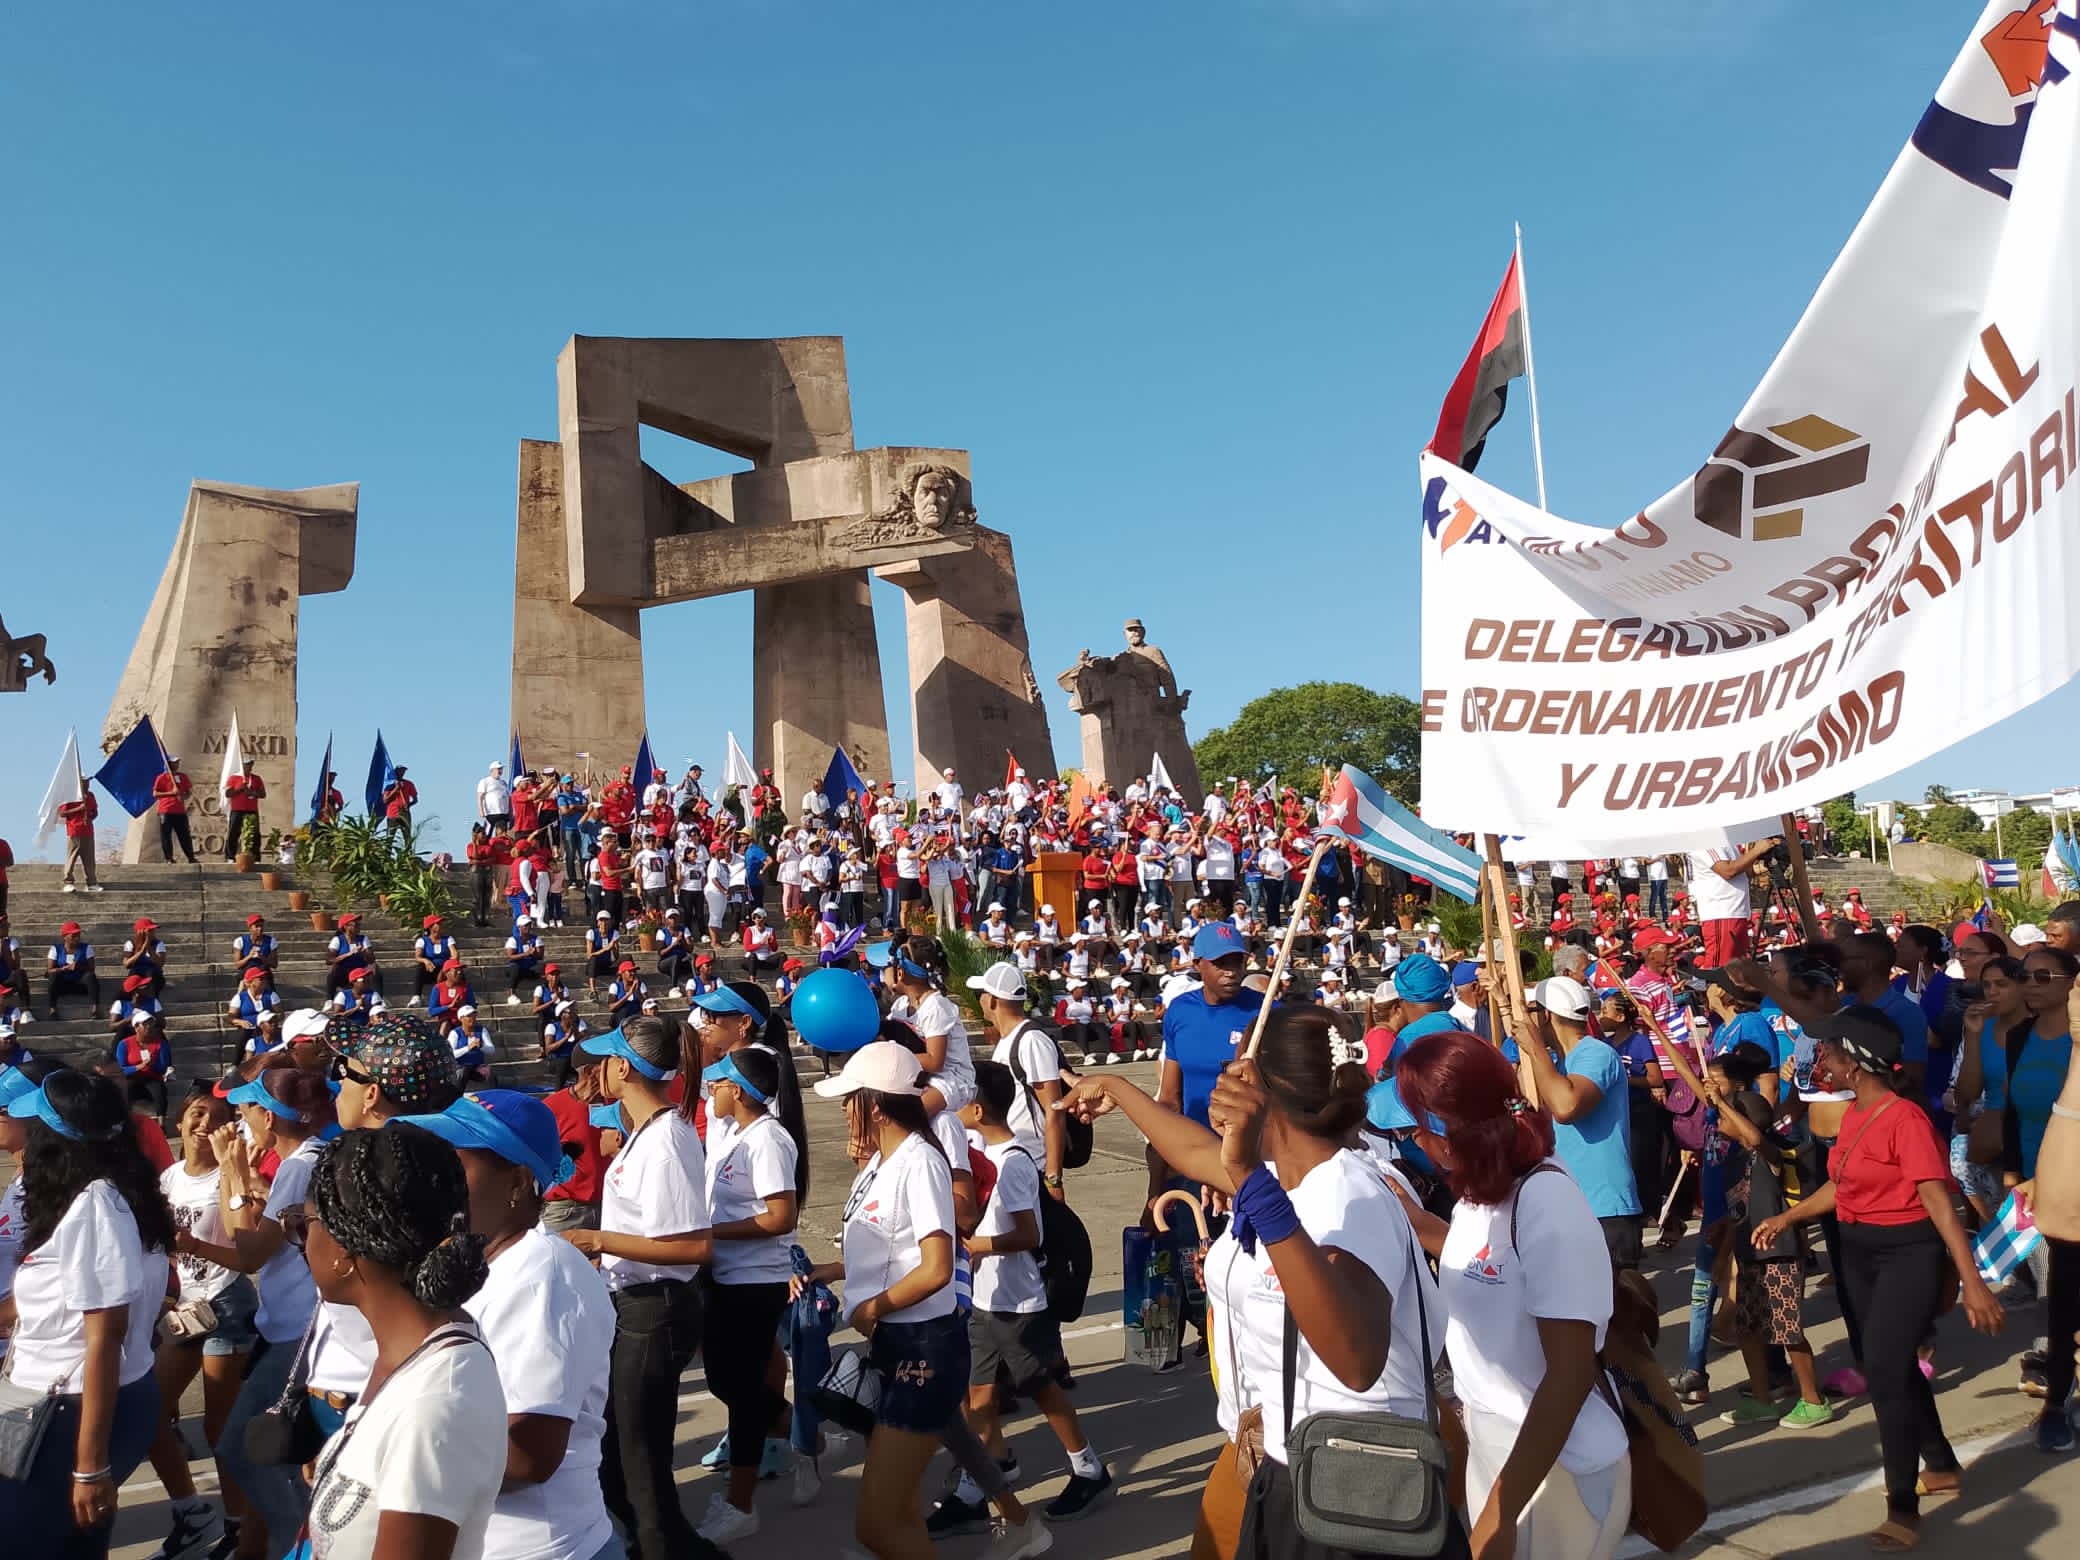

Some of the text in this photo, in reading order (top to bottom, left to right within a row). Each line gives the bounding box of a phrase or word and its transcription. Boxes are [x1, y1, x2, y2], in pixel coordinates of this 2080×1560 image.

[1421, 385, 2080, 735] E ORDENAMIENTO TERRITORI
[1556, 669, 1906, 811] Y URBANISMO
